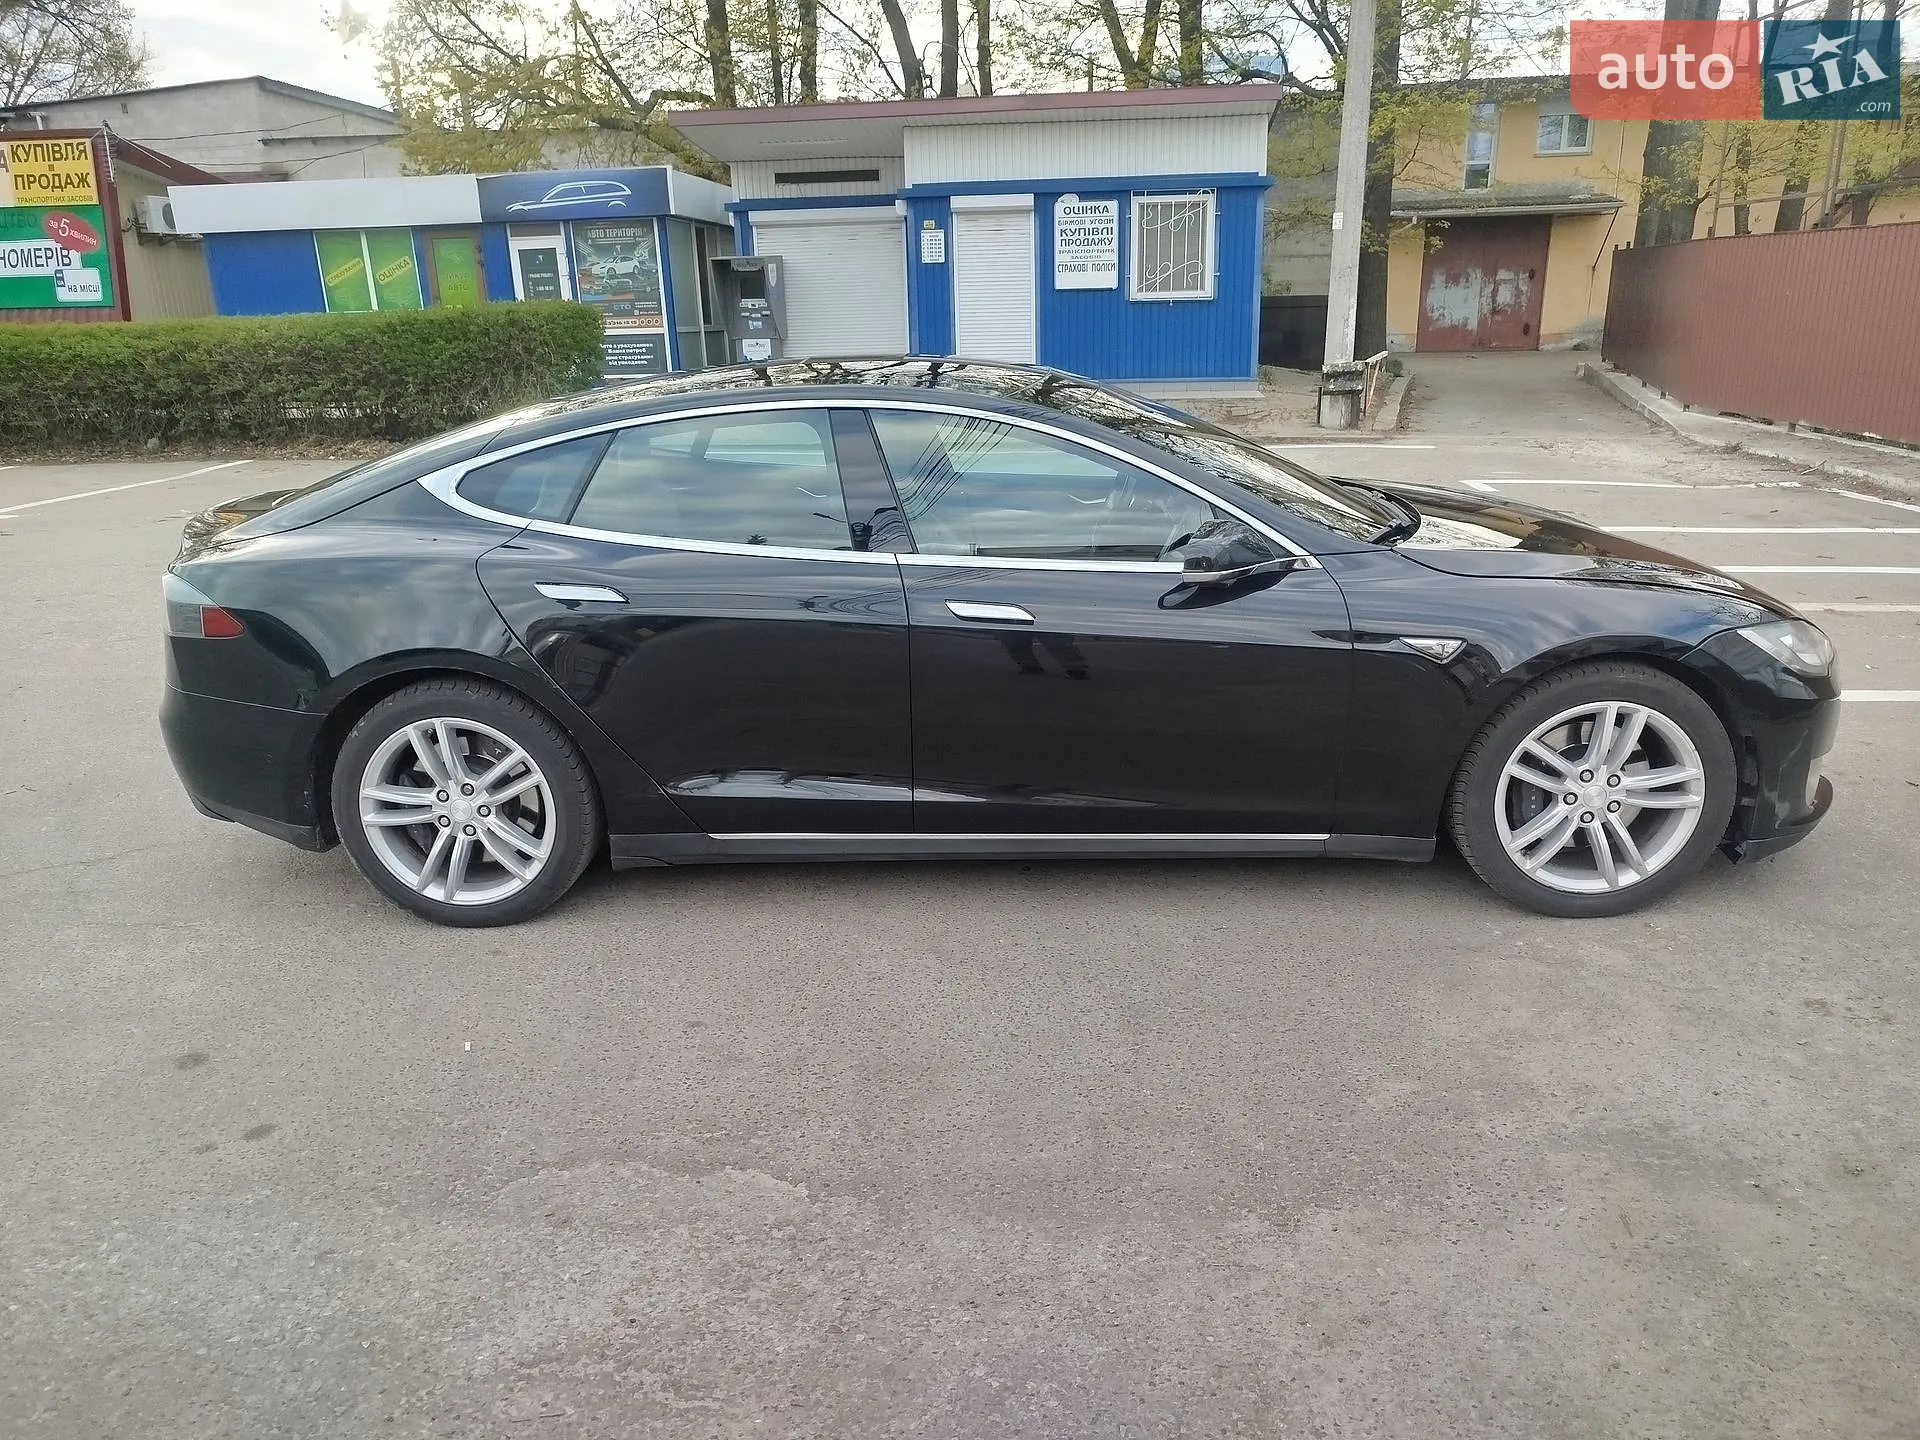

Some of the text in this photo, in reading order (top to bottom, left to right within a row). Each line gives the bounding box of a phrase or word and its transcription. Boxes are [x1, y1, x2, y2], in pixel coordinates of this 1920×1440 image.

[10, 142, 88, 163] КУПІВЛЯ
[14, 172, 91, 192] ПРОДАЖ
[17, 196, 65, 204] ТРАНСПОРТНИХ
[1063, 205, 1110, 215] ОЦІНКА
[48, 218, 97, 246] за 5 хвилин
[587, 229, 604, 238] АВТО
[1060, 227, 1113, 237] КУПІВЛІ
[1060, 237, 1113, 247] ПРОДАЖУ
[378, 259, 410, 282] ОЦІНКА
[1057, 262, 1116, 273] СТРАХОВІ ПОЛІСИ
[67, 281, 100, 294] на місці
